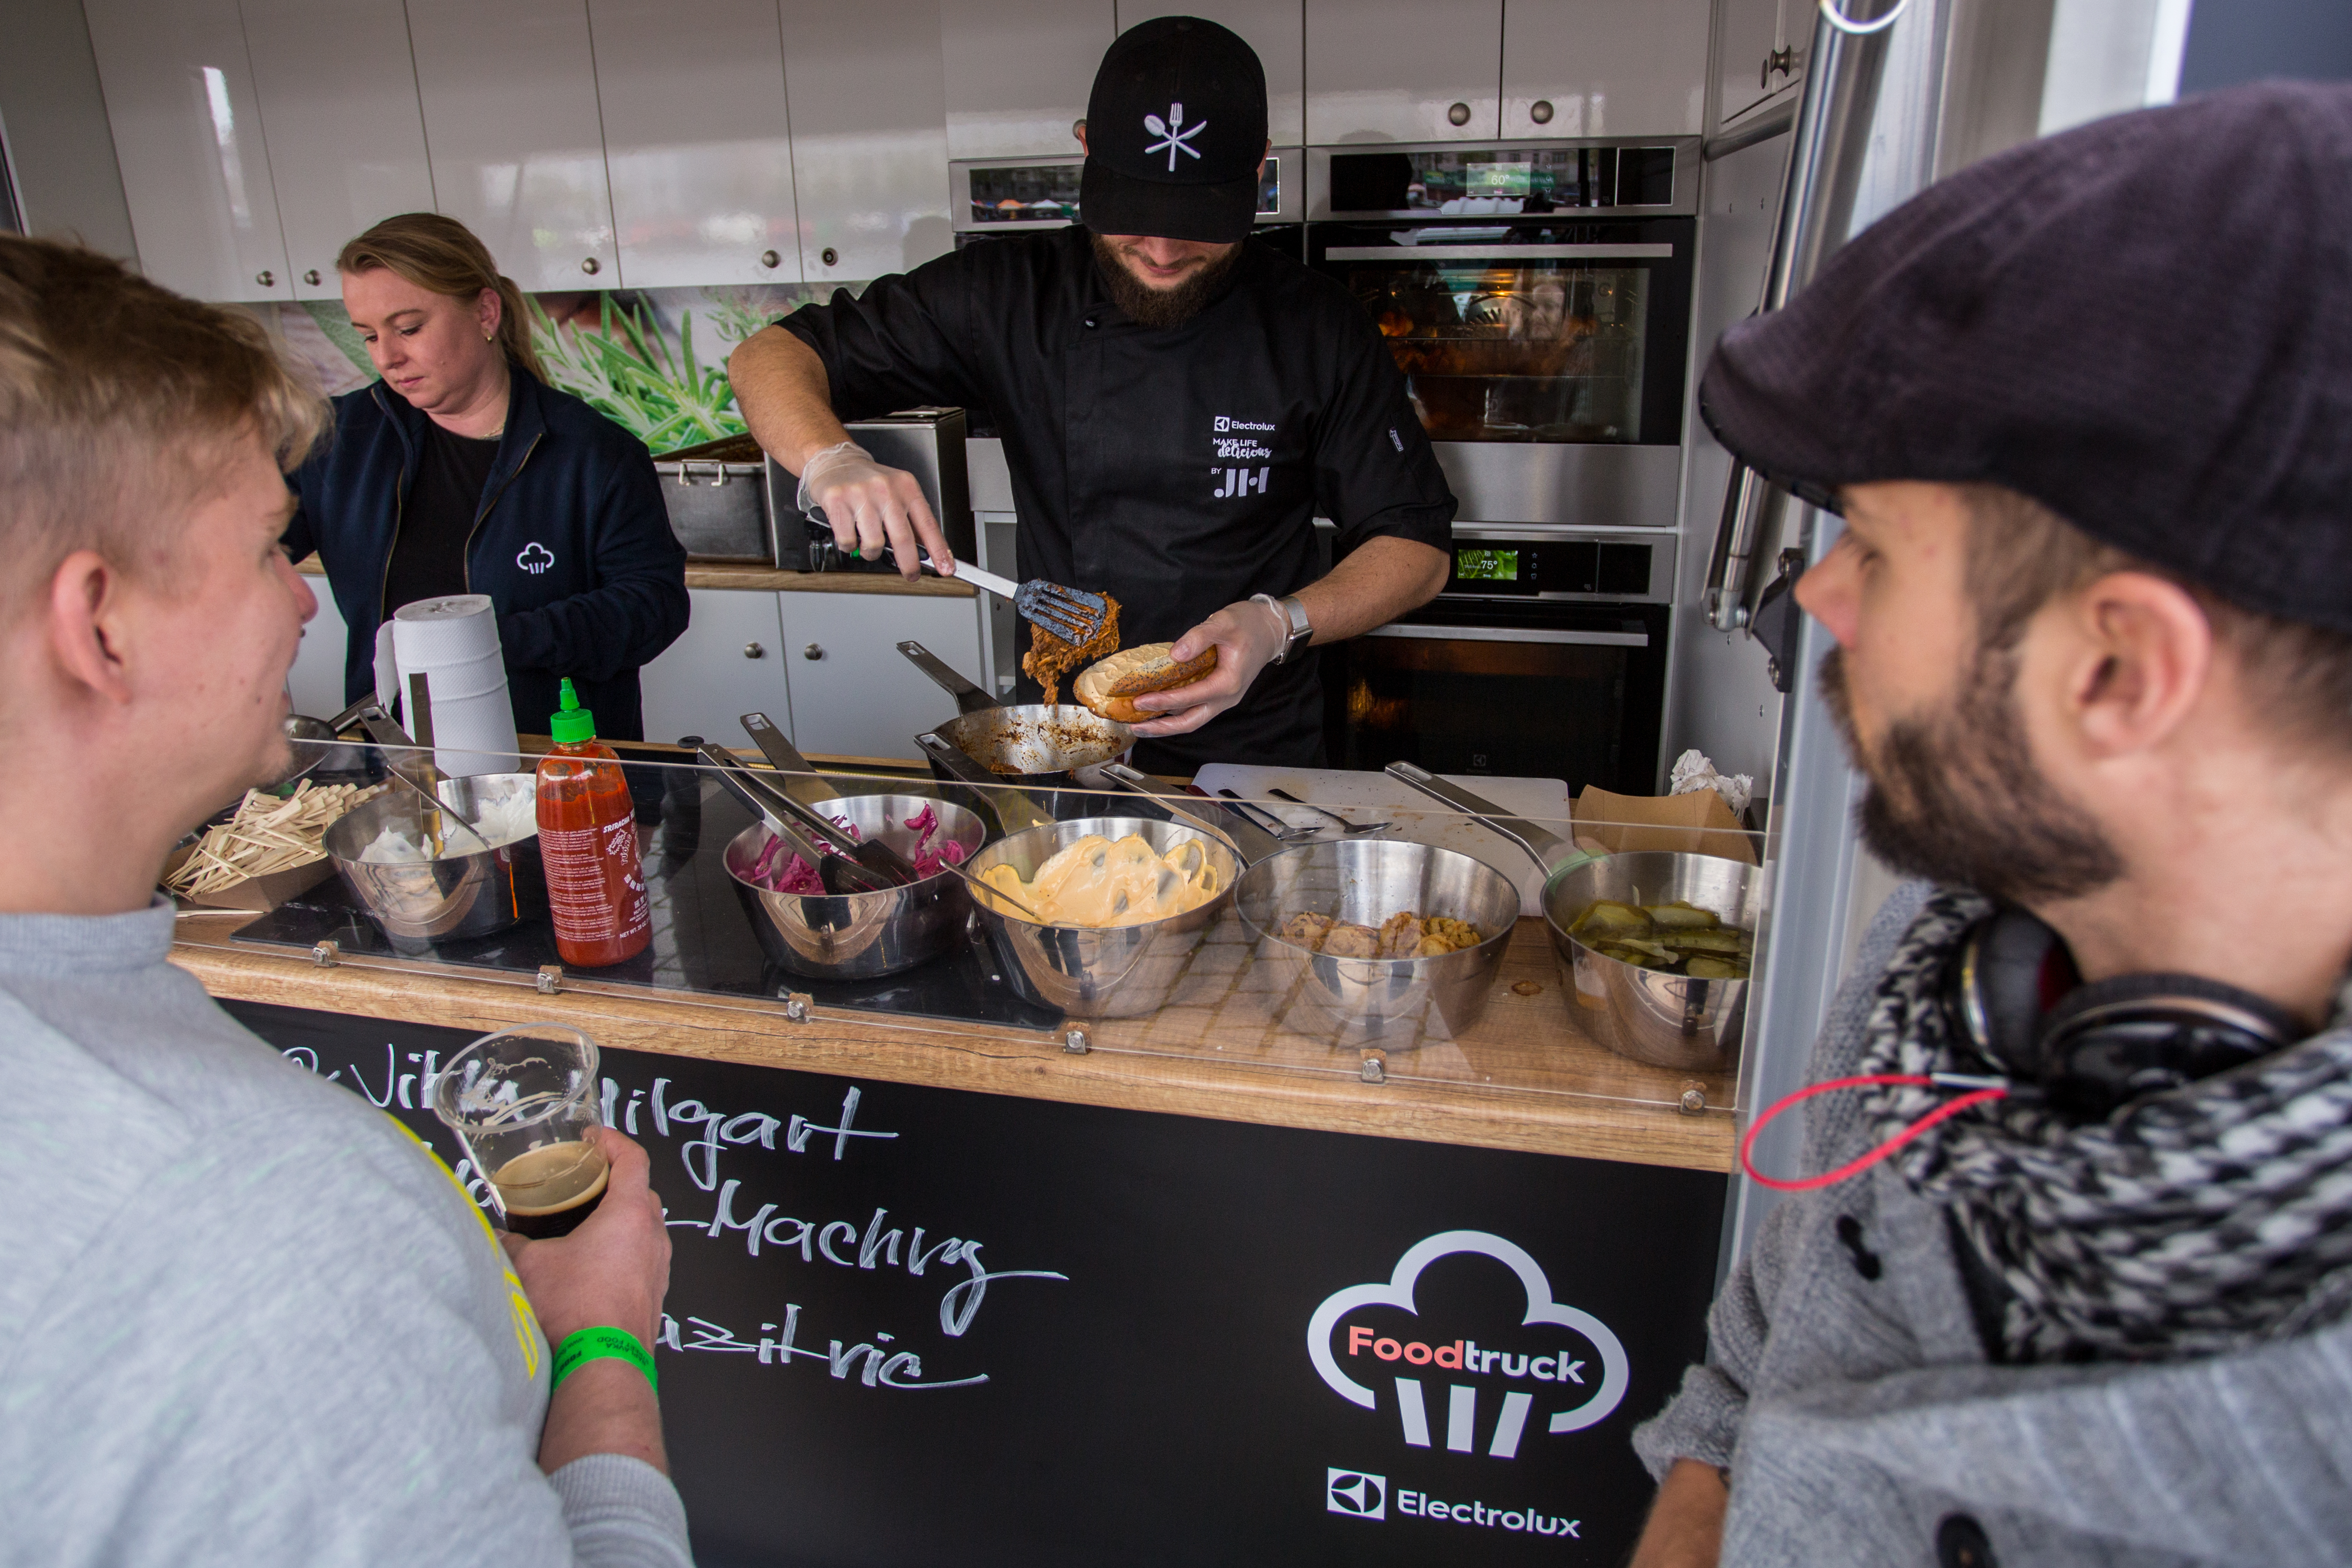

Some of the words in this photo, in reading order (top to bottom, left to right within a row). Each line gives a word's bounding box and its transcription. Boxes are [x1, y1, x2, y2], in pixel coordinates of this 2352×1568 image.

[1232, 421, 1276, 431] Electrolux
[1213, 437, 1238, 446] MAKE
[1240, 439, 1258, 447] LIFE
[1217, 443, 1272, 459] delicious
[603, 815, 630, 833] SRIRACHA
[1348, 1325, 1586, 1384] Foodtruck
[1397, 1488, 1581, 1538] Electrolux
